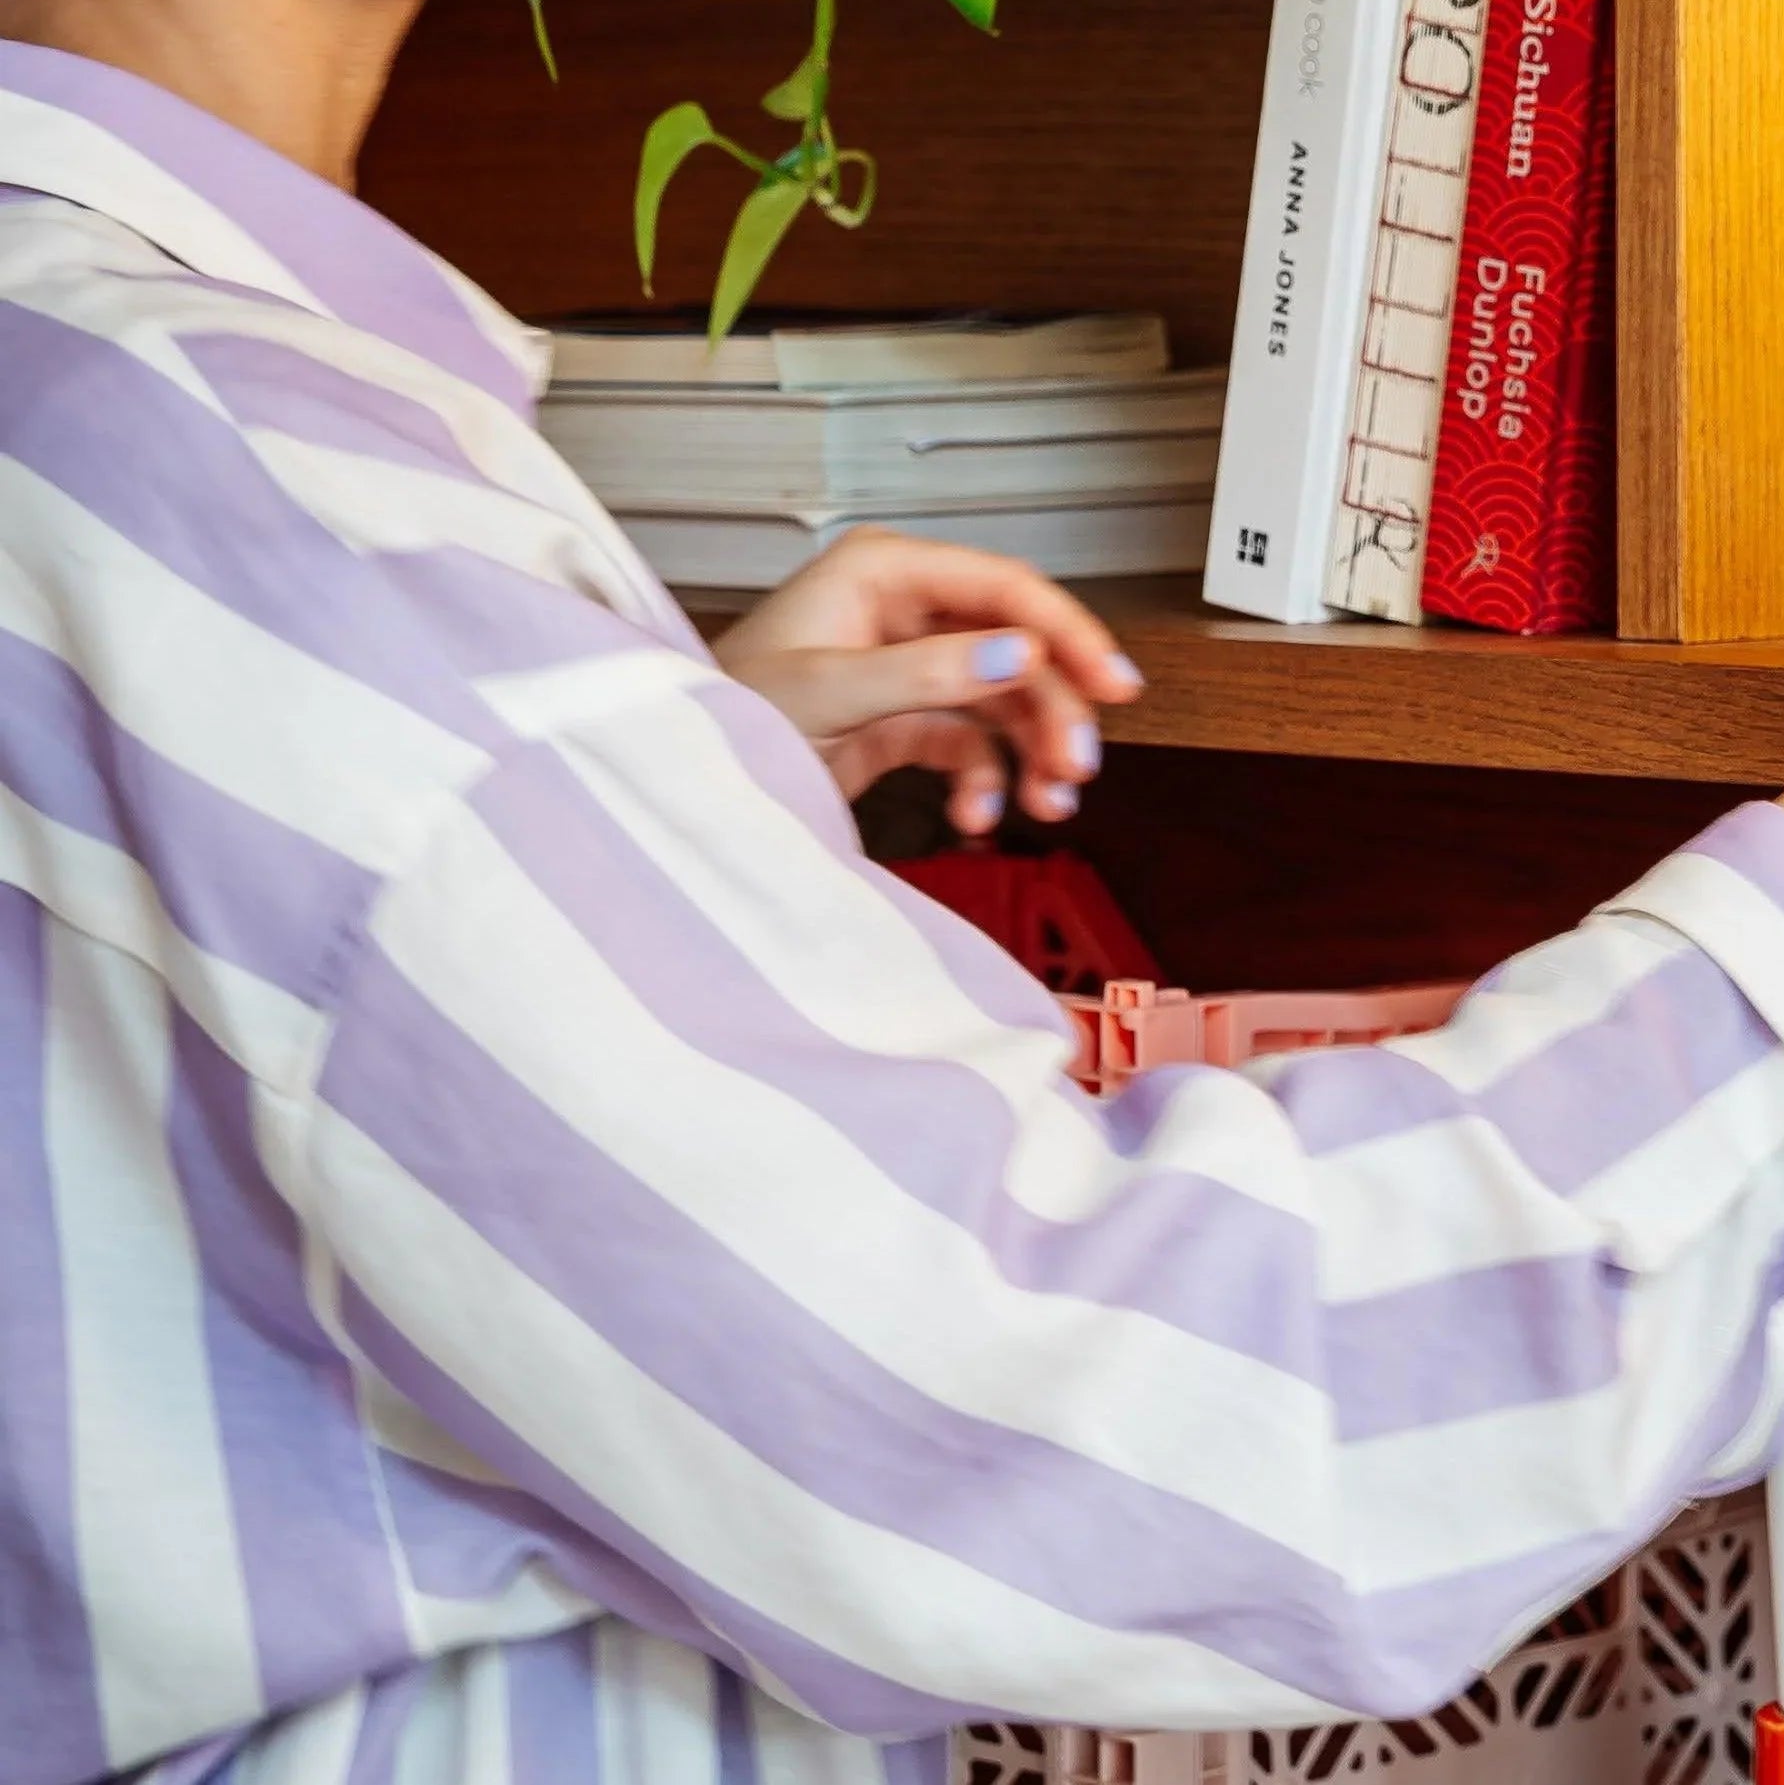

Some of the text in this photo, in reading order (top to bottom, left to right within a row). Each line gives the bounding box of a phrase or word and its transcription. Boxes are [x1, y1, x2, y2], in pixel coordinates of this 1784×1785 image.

[1299, 12, 1325, 101] cook
[1268, 140, 1309, 358] ANNA JONES
[1456, 257, 1508, 420] Dunlop
[1498, 263, 1545, 440] Fuchsia
